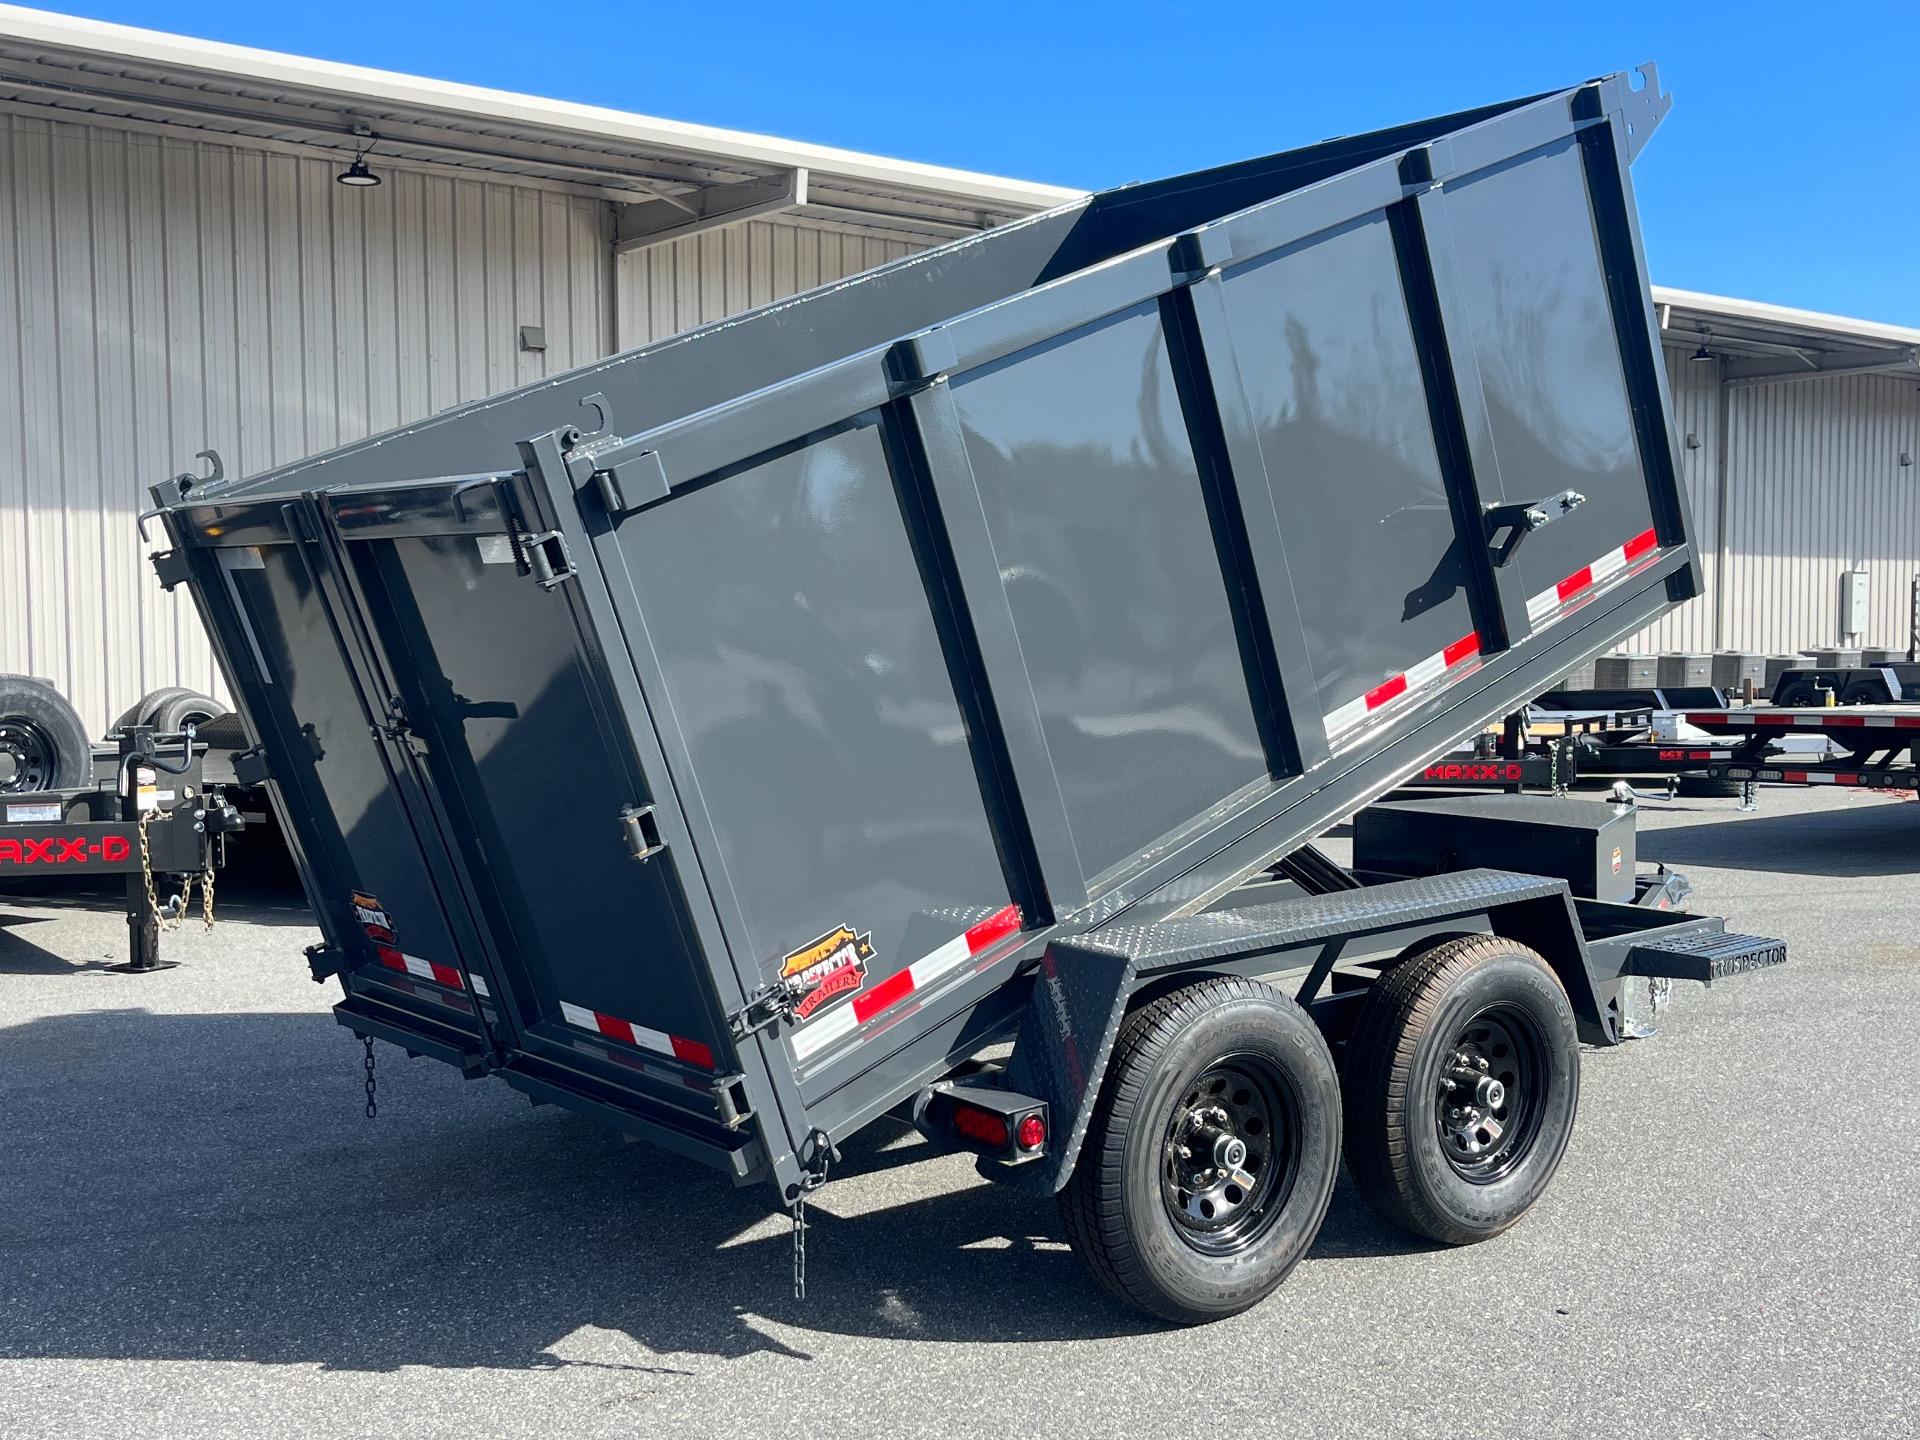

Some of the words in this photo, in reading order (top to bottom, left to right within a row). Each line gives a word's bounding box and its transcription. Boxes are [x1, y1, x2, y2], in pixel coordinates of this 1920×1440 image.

[1424, 764, 1521, 780] MAXX-D
[1711, 945, 1787, 979] PROSPECTOR
[801, 975, 858, 1012] TRAILERS
